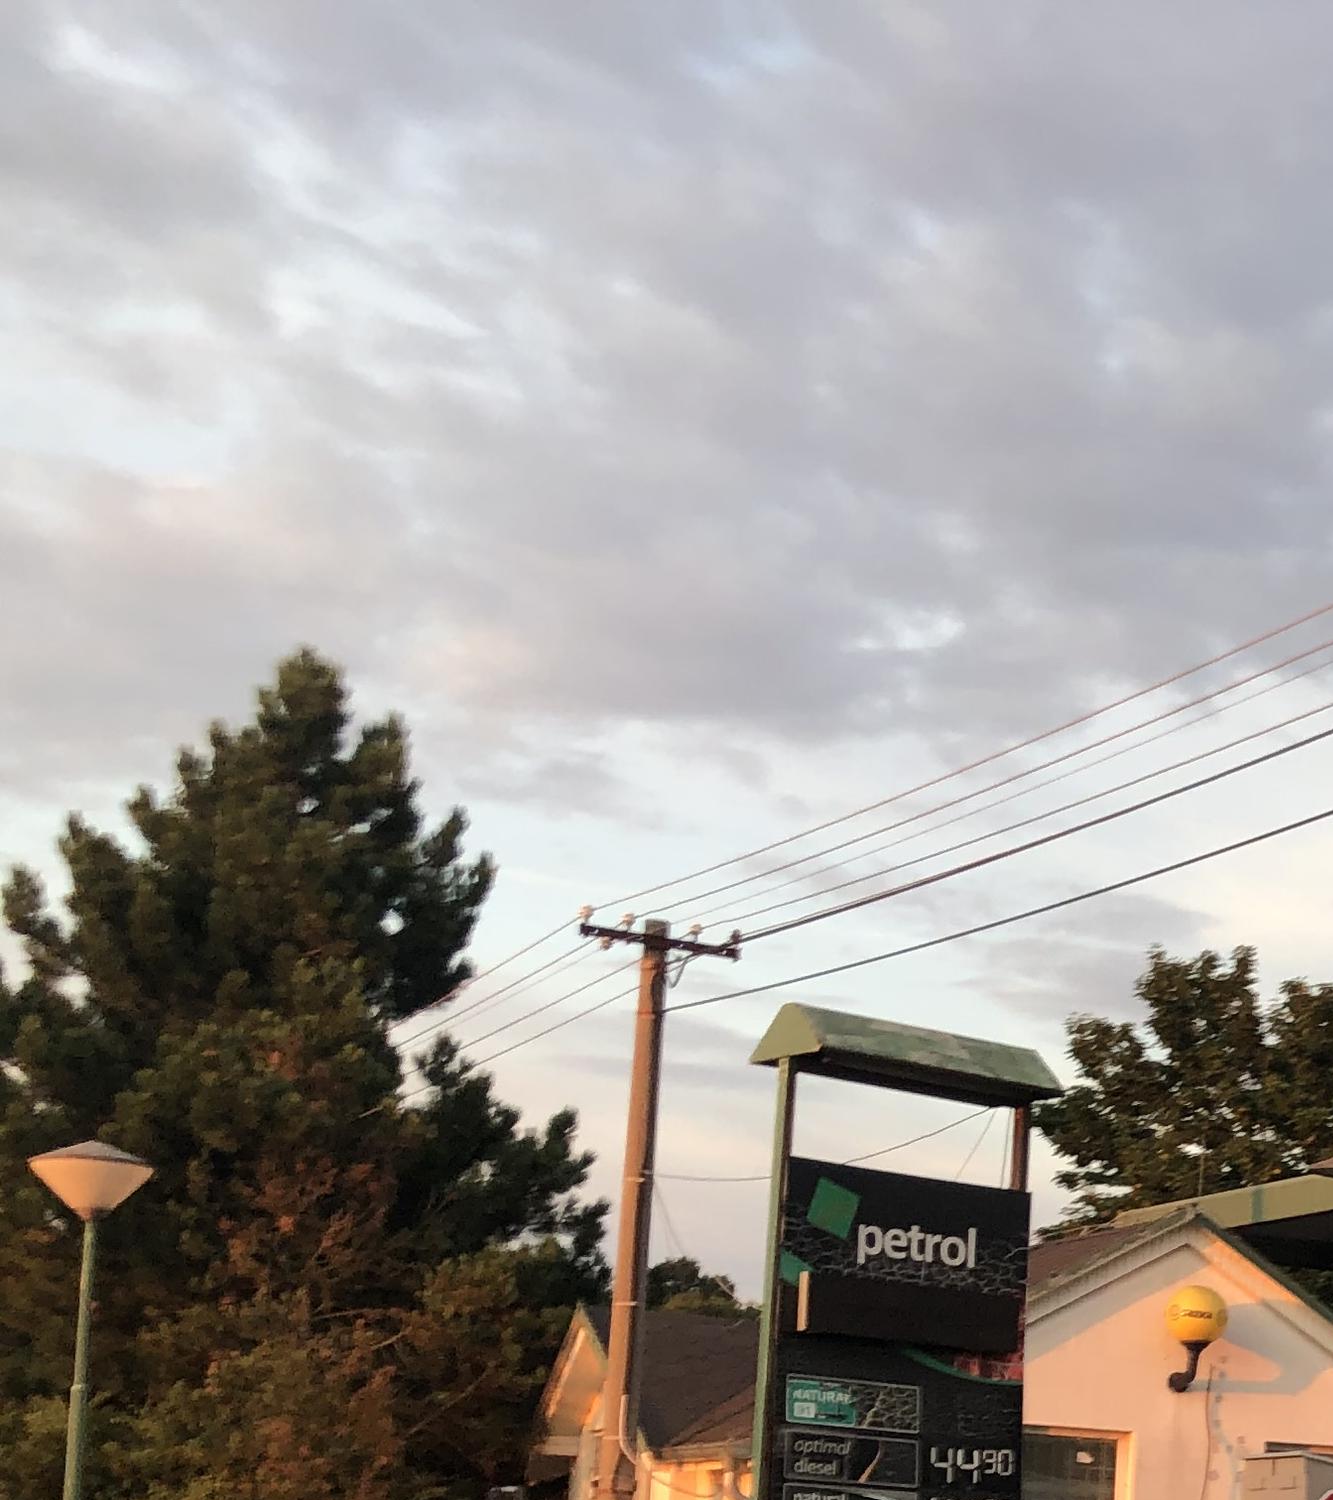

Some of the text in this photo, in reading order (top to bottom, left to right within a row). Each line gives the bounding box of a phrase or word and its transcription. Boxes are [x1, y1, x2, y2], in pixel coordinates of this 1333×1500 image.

[857, 1224, 977, 1268] petrol
[794, 1437, 850, 1455] optimal
[794, 1458, 836, 1475] diesel
